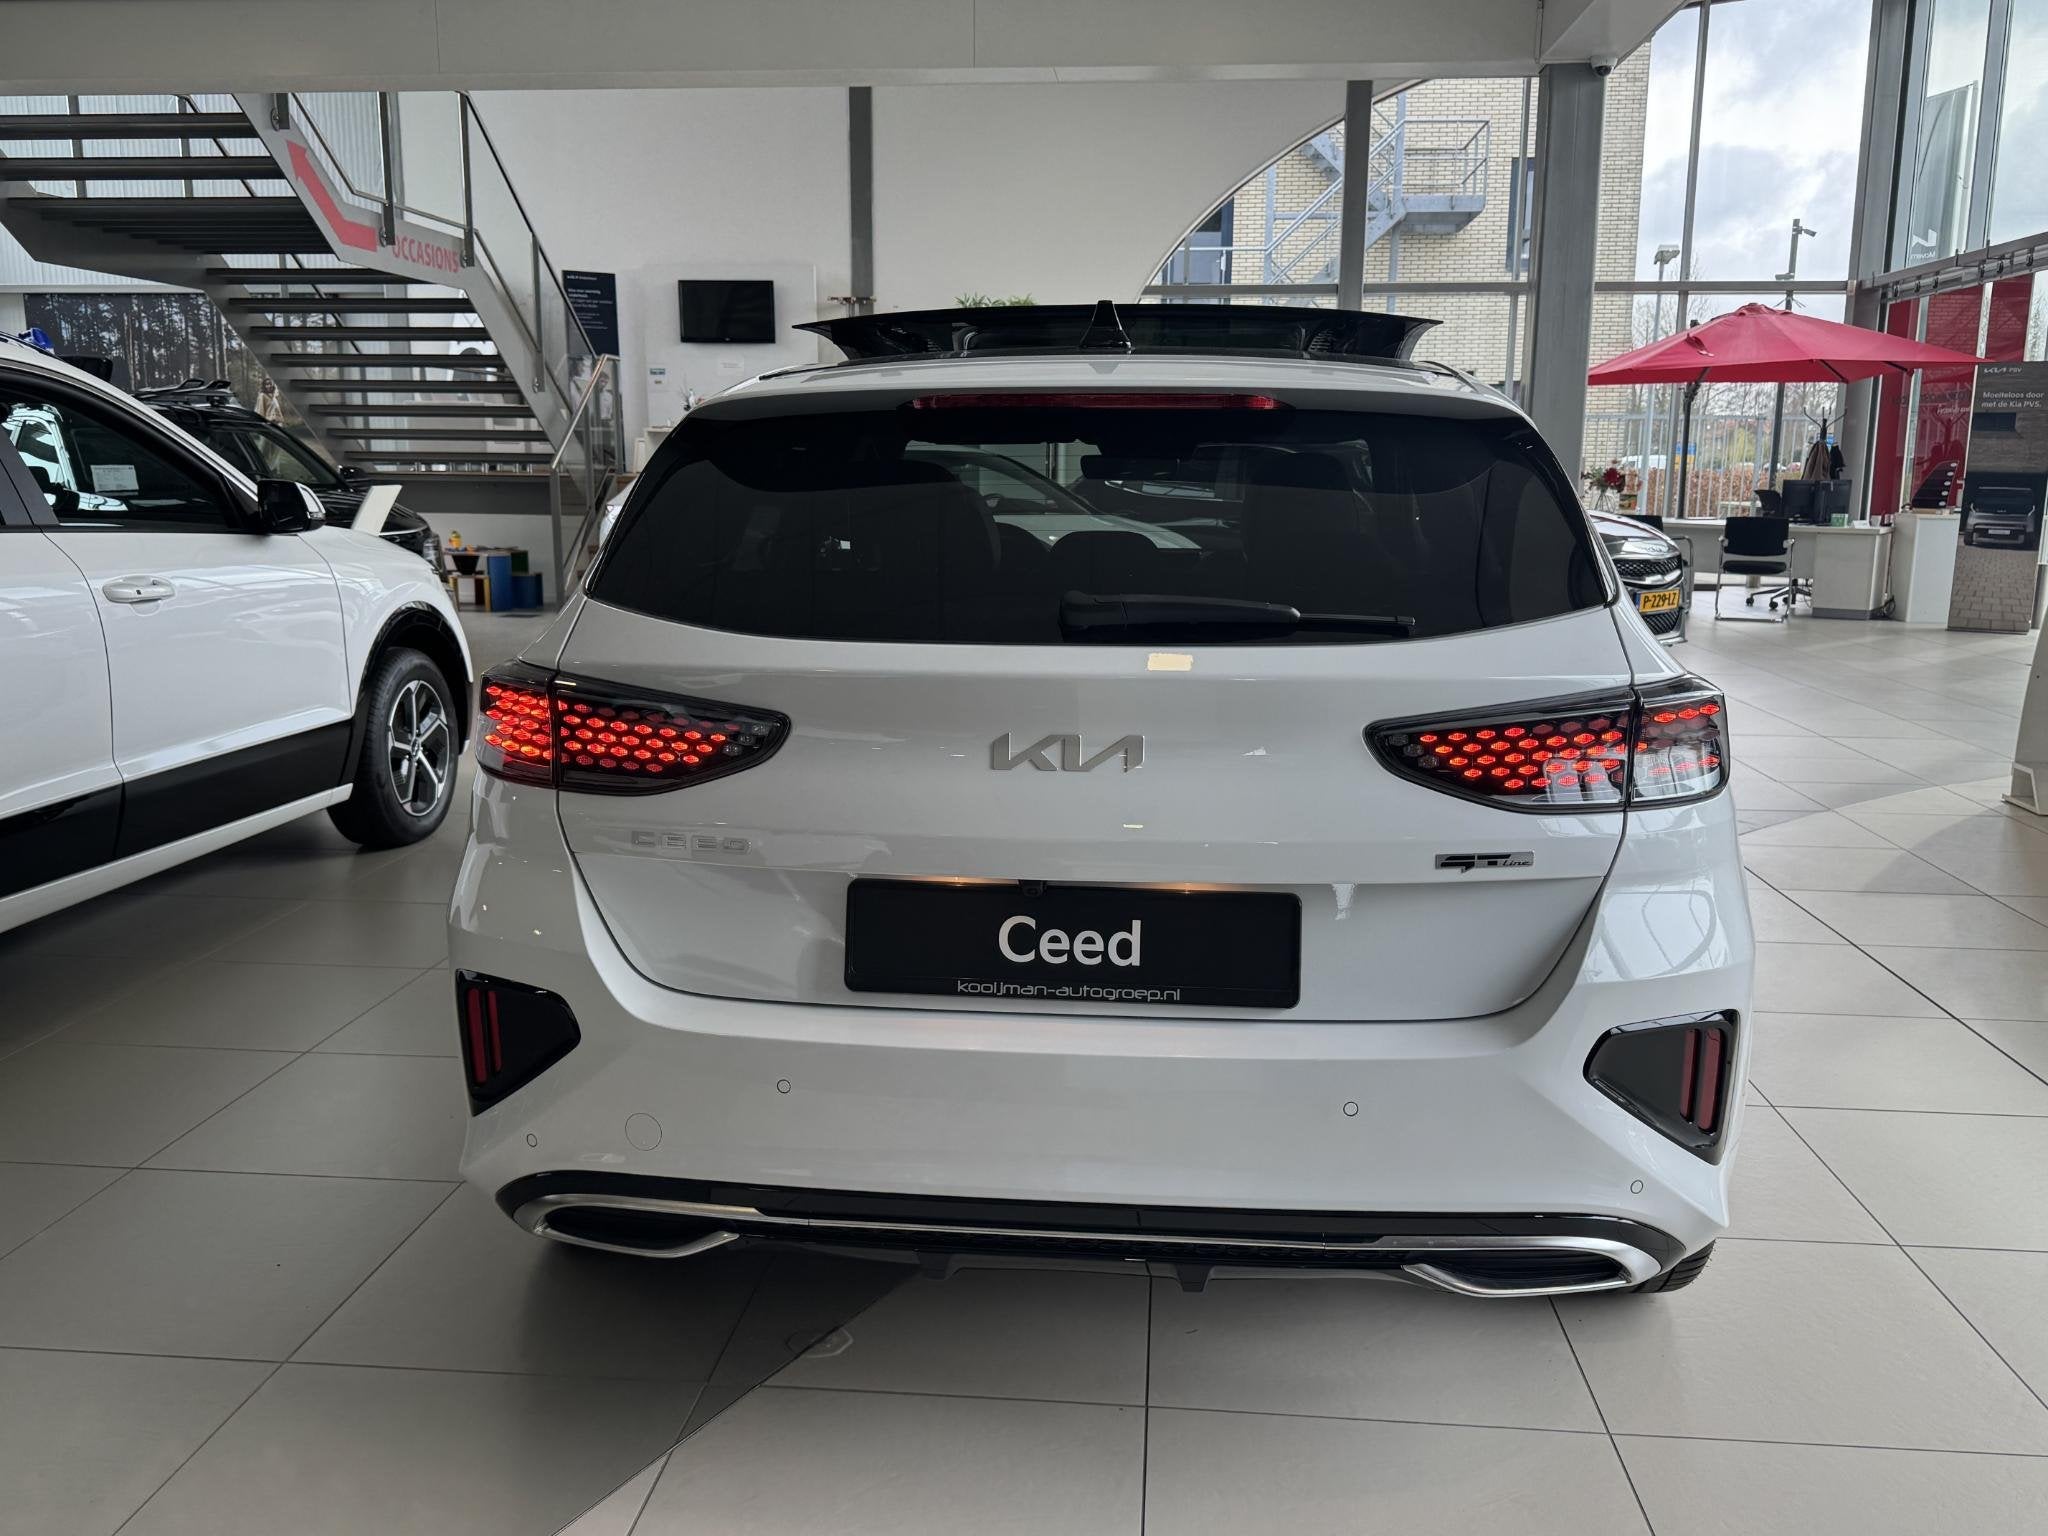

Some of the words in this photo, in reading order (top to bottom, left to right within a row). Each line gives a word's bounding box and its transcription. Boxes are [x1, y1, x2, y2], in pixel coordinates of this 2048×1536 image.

[392, 236, 459, 273] OCCASIONS
[1642, 592, 1677, 609] P-229-LZ
[992, 732, 1145, 772] KIA
[998, 915, 1142, 967] Ceed
